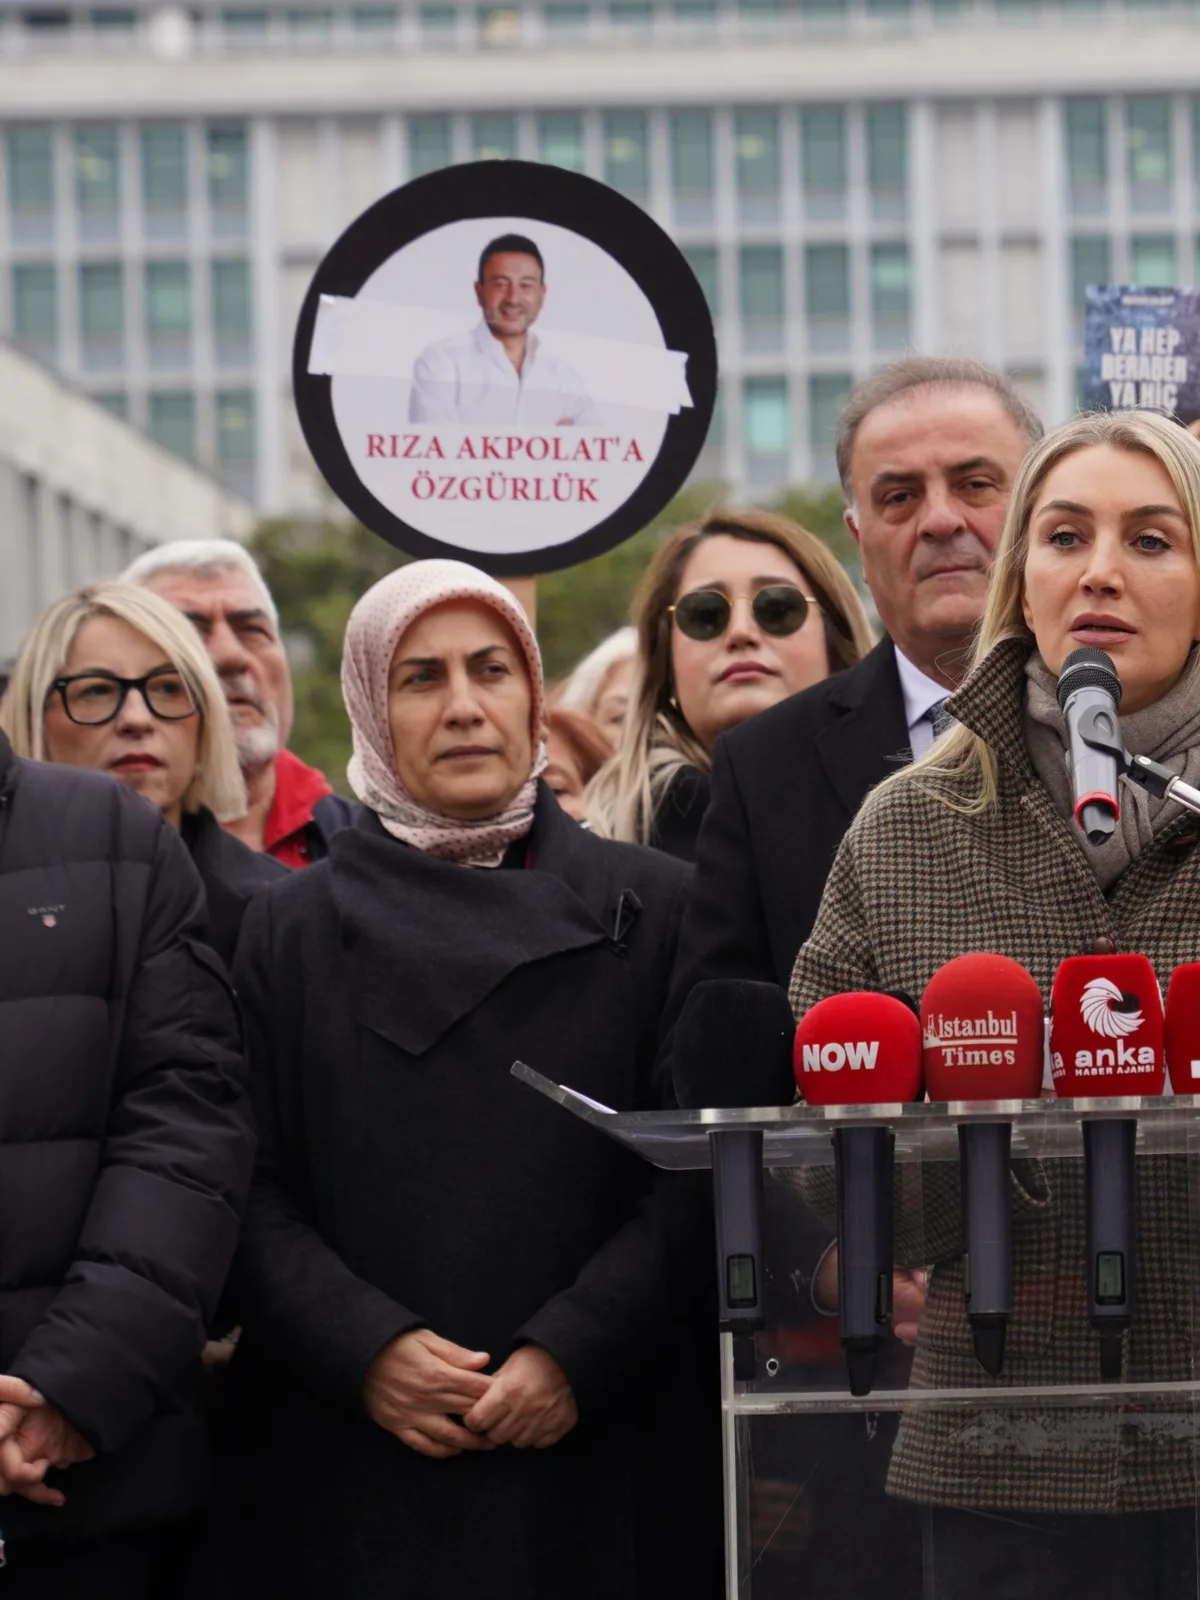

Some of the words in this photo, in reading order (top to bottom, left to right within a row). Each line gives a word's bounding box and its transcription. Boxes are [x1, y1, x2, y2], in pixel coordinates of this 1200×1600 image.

[1109, 326, 1137, 354] YA
[1141, 327, 1180, 355] HEP
[1109, 381, 1137, 408] YA
[366, 433, 445, 460] RIZA
[456, 435, 645, 463] AKPOLAT'A
[410, 470, 600, 503] ÖZGÜRLÜK
[27, 904, 67, 916] GANT
[802, 1041, 880, 1073] NOW
[941, 1046, 1016, 1067] Times
[1074, 1038, 1156, 1069] anka
[1075, 1066, 1114, 1077] HABER
[1116, 1064, 1155, 1075] AJANSI
